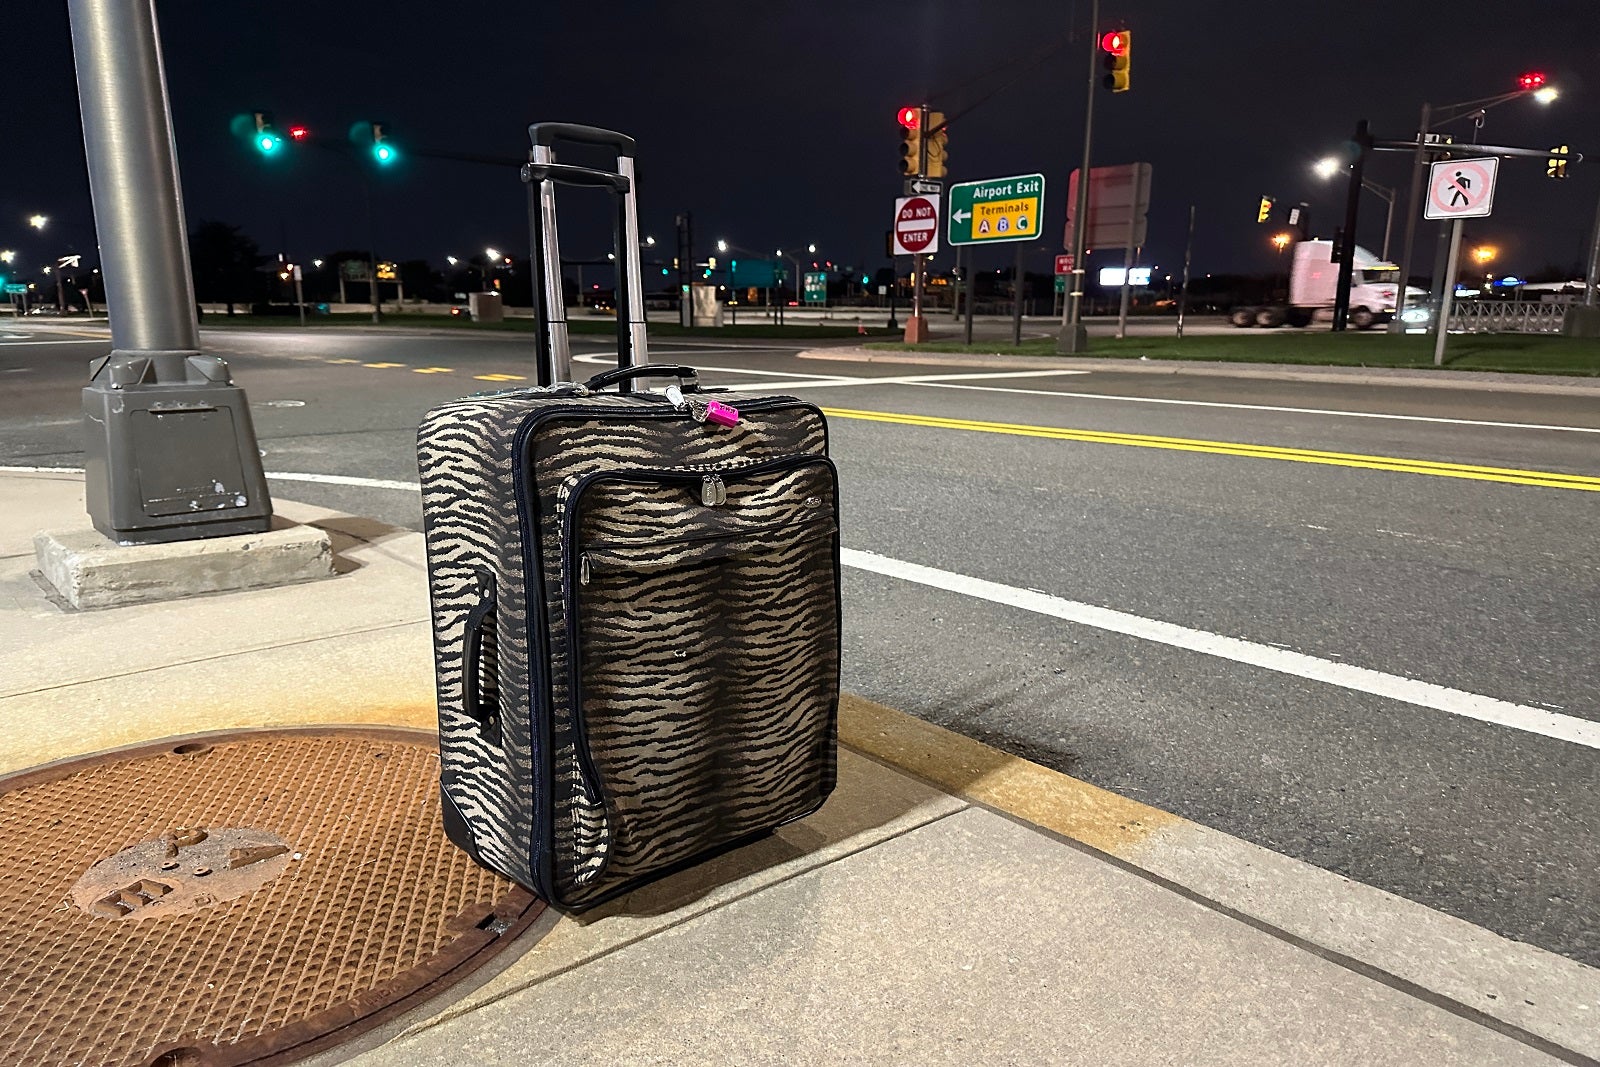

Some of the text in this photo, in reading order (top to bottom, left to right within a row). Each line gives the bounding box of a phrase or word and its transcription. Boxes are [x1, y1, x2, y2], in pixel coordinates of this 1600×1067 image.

[973, 180, 1039, 200] Airport Exit
[902, 207, 931, 219] DO NOT
[980, 202, 1029, 215] Terminals
[979, 216, 1027, 233] A B C
[903, 232, 928, 243] ENTER
